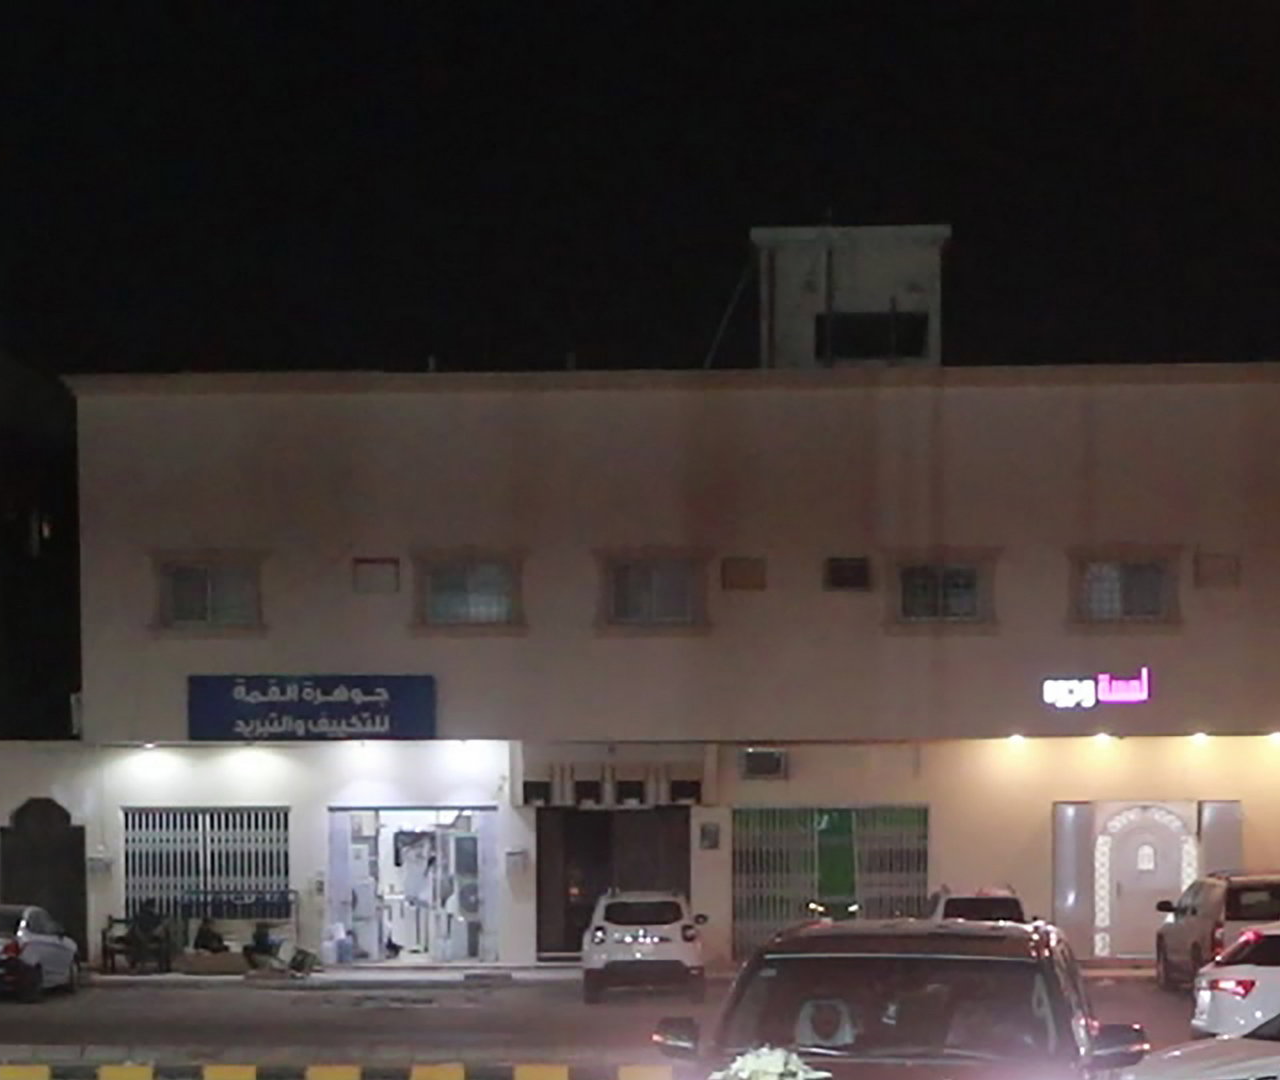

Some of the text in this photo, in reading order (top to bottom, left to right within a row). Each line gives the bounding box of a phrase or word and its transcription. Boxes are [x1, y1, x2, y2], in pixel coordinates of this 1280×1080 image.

[233, 678, 390, 708] جوهرة القمة
[233, 712, 390, 738] للتكييف والتبريد
